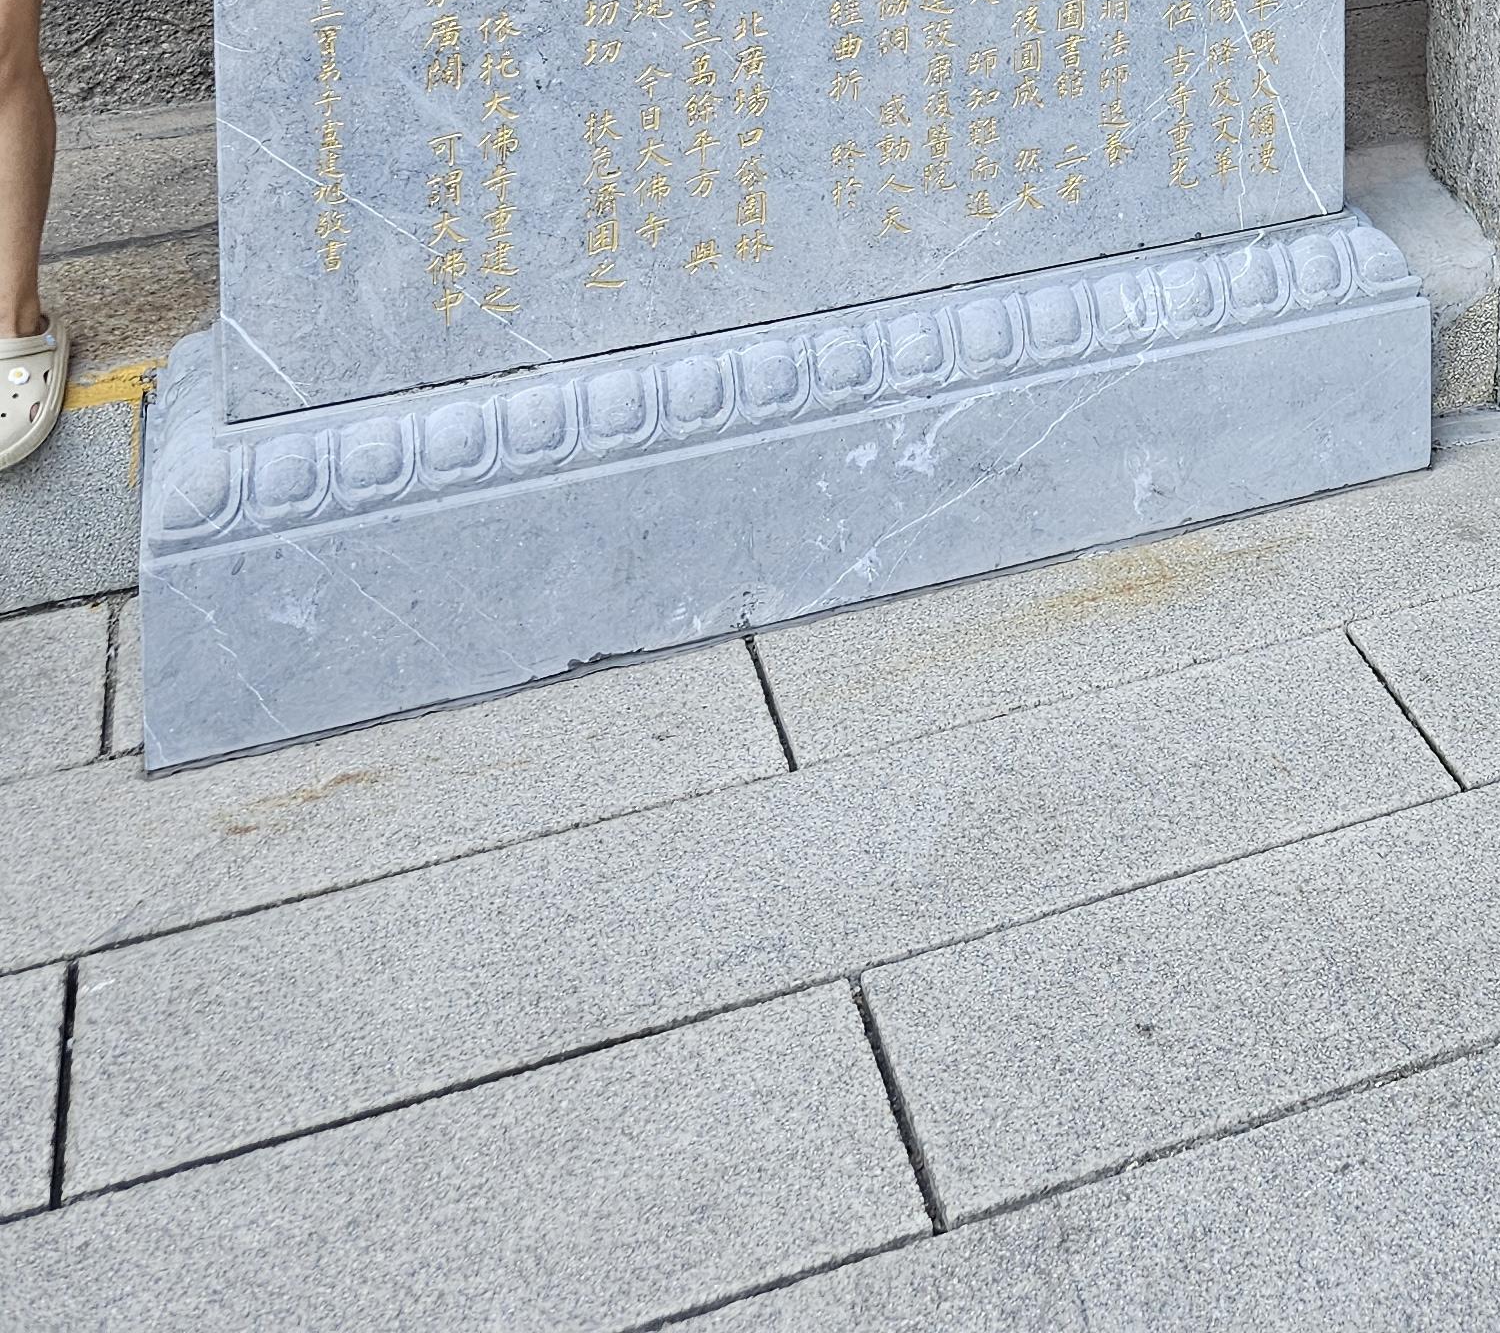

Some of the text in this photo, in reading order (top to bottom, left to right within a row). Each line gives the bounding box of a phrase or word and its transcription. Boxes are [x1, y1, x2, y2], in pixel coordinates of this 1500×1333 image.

[584, 108, 625, 289] 扶危濟困之
[639, 64, 671, 246] 今日大佛寺
[831, 140, 864, 207] 終於
[879, 94, 912, 235] 感動人天
[968, 49, 998, 220] 師知難而進
[1016, 147, 1042, 210] 然大
[1055, 142, 1088, 203] 二者
[427, 131, 467, 325] 可謂大佛中
[684, 237, 720, 272] 與
